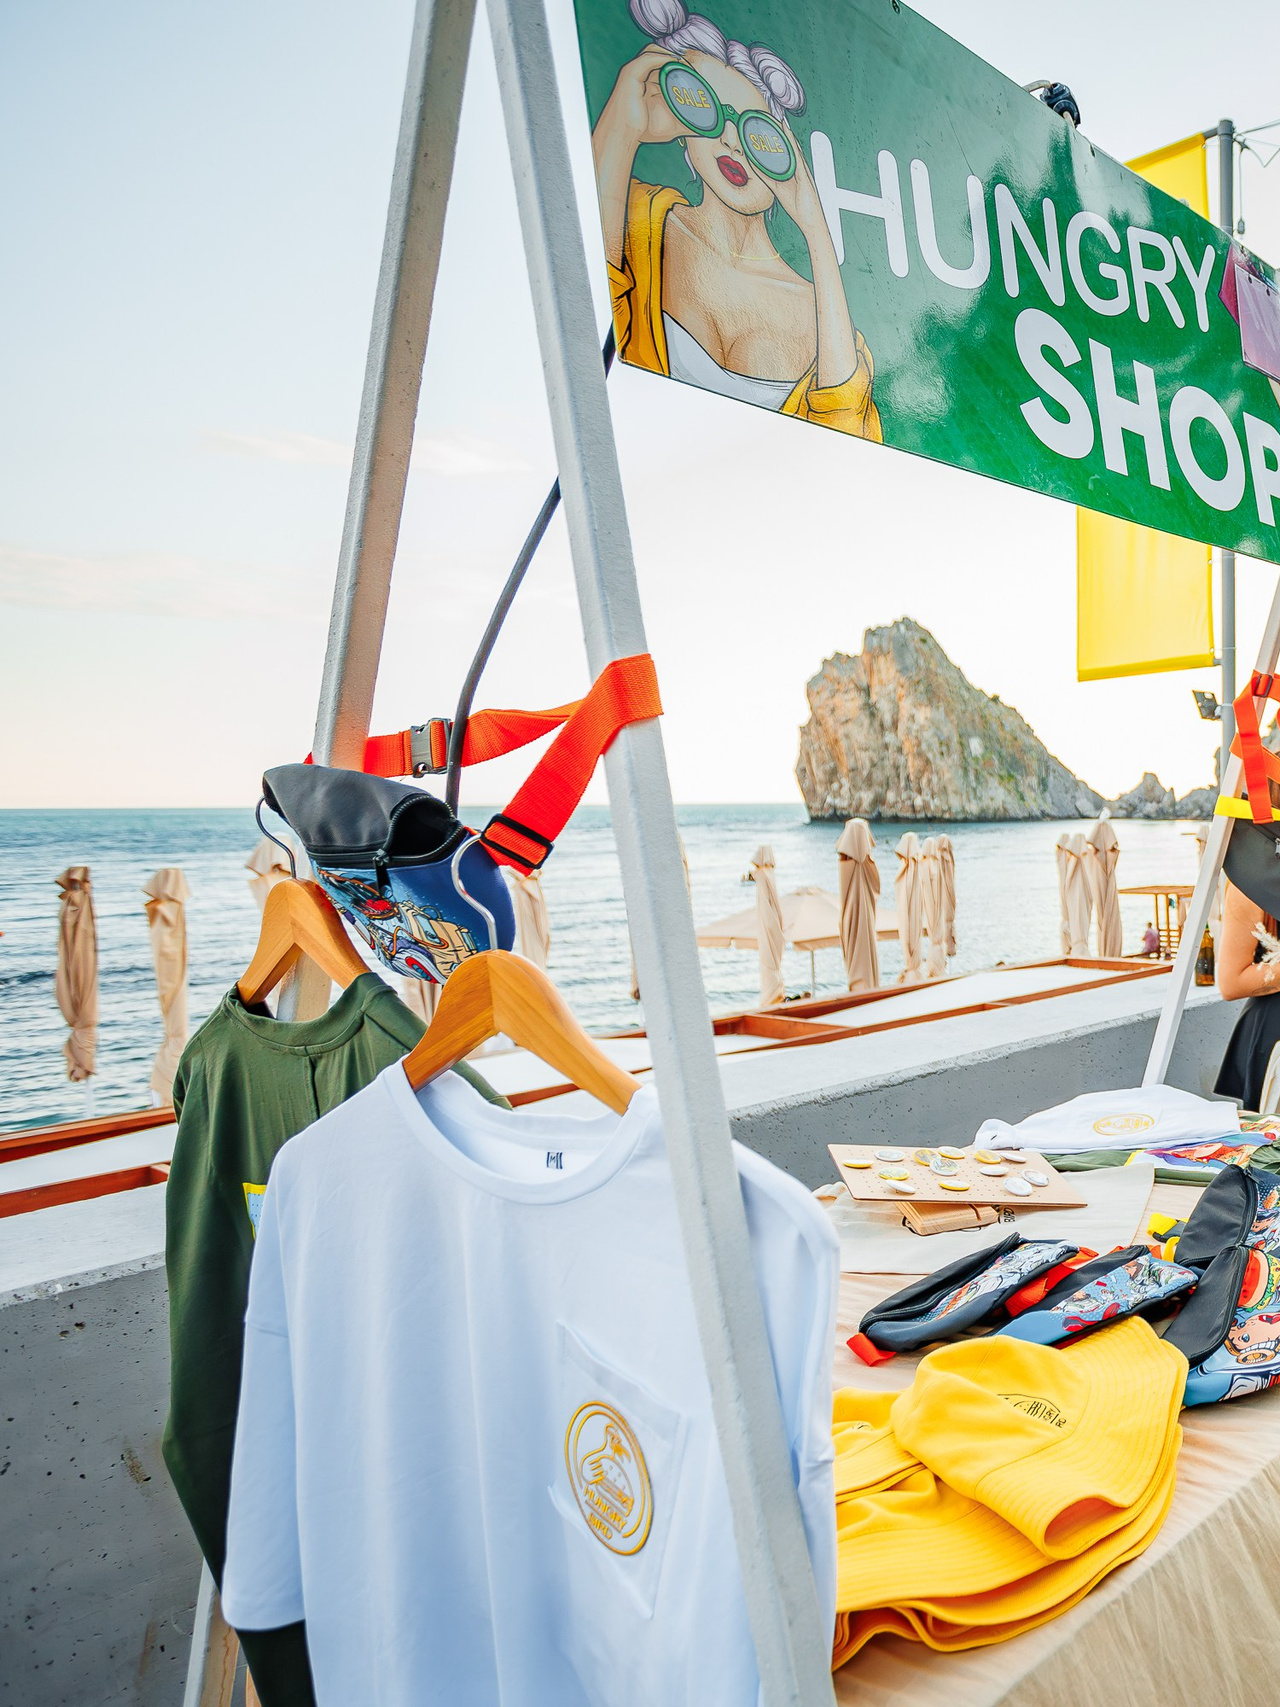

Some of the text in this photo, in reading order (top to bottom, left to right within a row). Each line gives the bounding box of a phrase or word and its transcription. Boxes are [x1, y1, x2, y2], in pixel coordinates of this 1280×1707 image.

[671, 85, 711, 109] SALE
[749, 133, 785, 154] SALE
[809, 130, 1219, 334] HUNGRY
